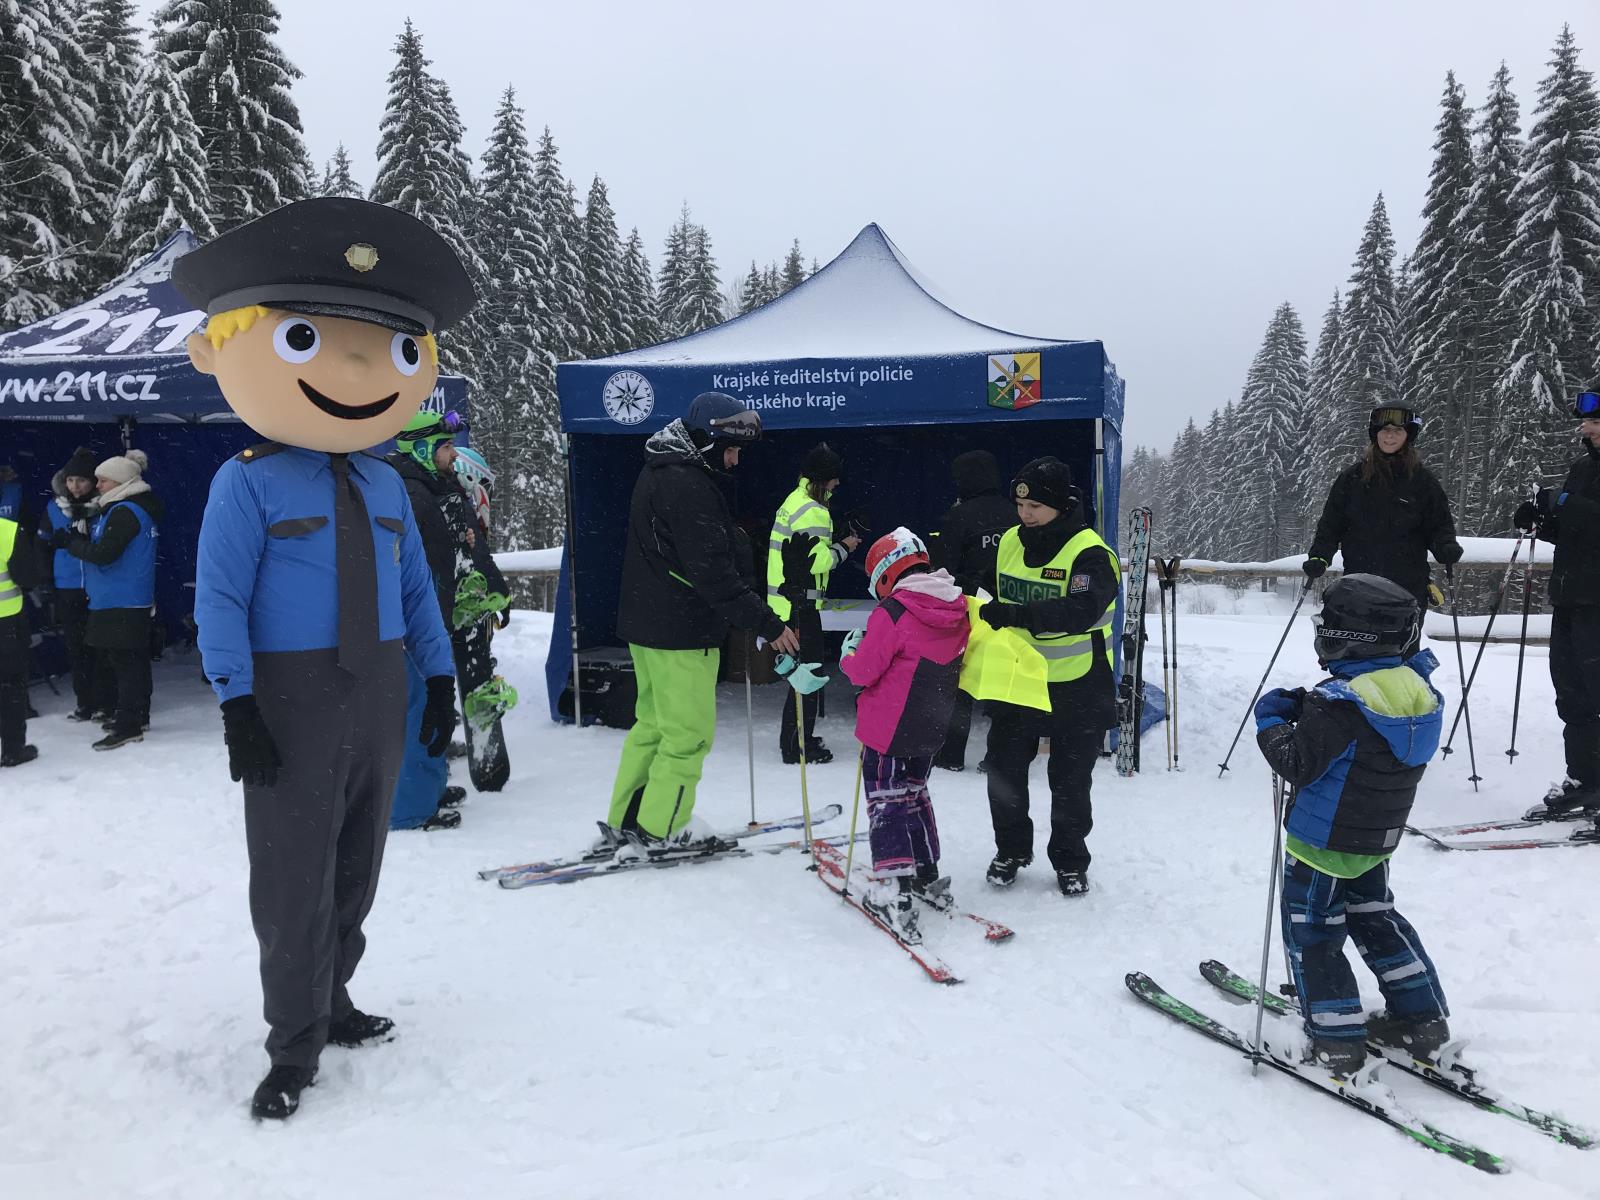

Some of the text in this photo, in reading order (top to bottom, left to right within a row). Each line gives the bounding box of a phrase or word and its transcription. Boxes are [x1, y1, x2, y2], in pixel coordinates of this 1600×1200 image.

[20, 307, 207, 354] 211
[713, 366, 914, 392] Krajské ředitelství policie
[806, 392, 846, 411] kraje
[1000, 577, 1060, 604] POLICIE
